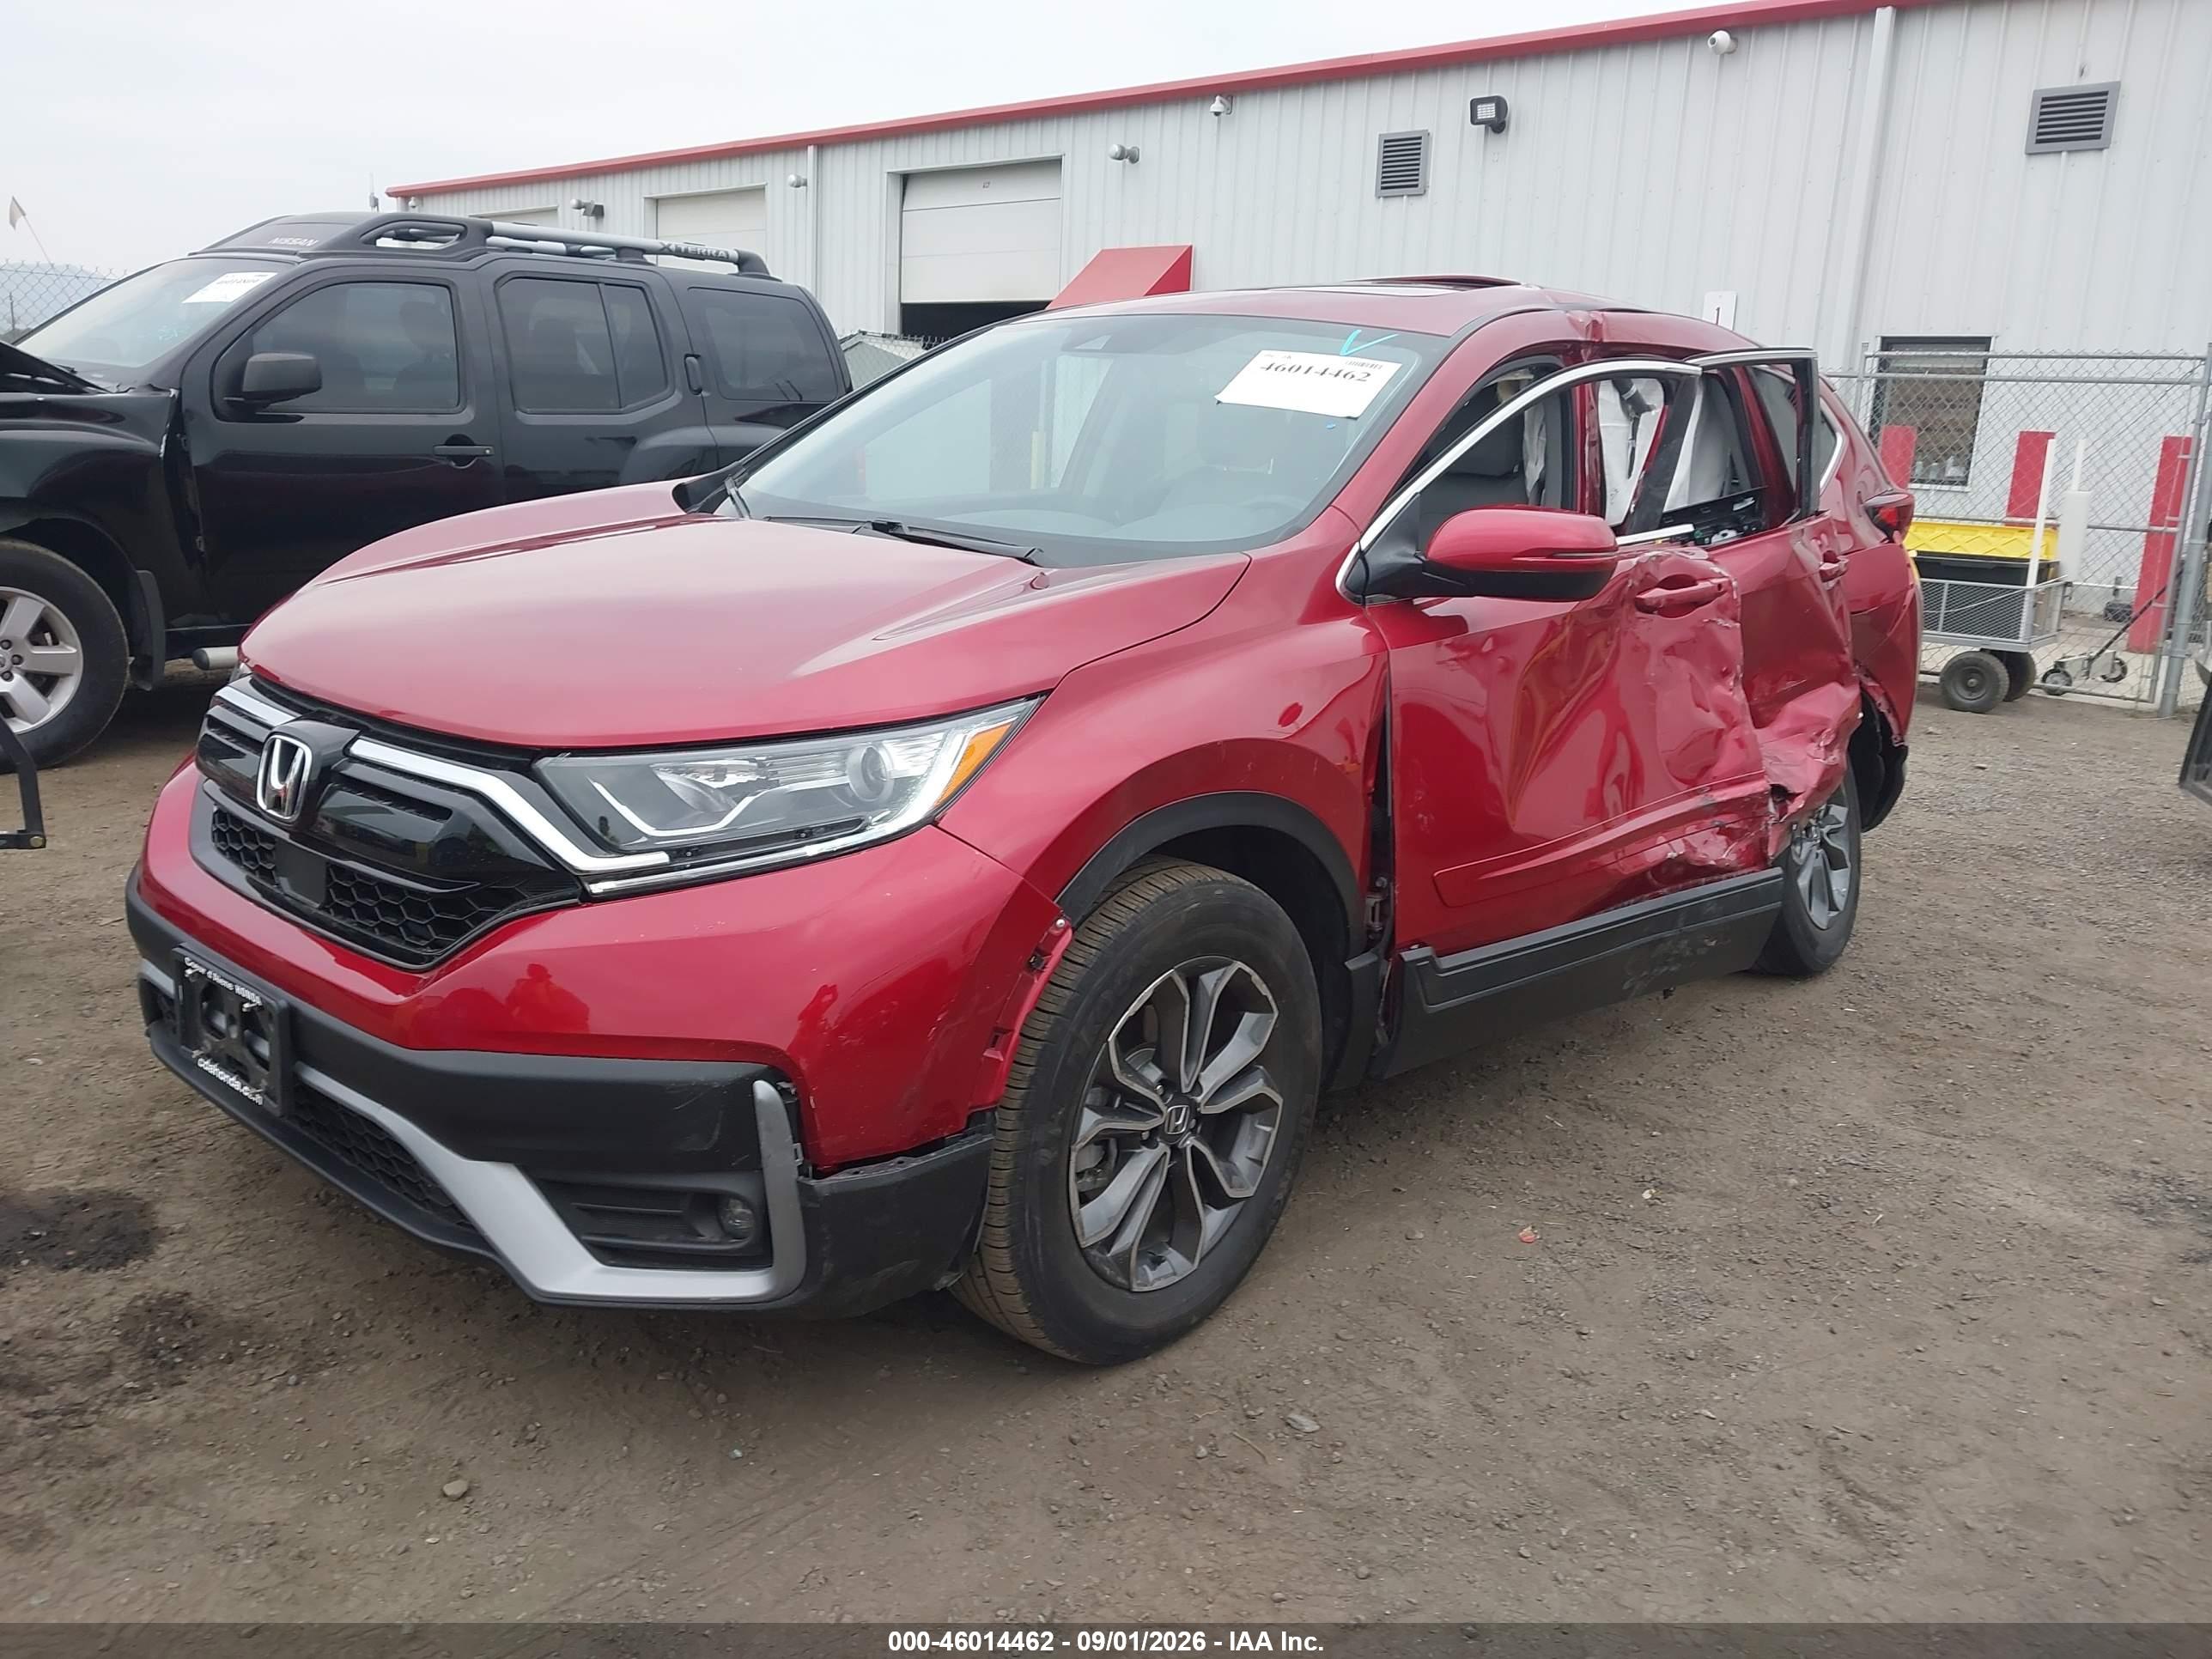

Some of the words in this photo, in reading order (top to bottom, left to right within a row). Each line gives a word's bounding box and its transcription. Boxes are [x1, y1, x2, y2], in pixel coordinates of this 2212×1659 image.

[268, 237, 319, 247] NISSAN
[659, 241, 729, 258] XTERRA
[1260, 362, 1372, 382] 46014462
